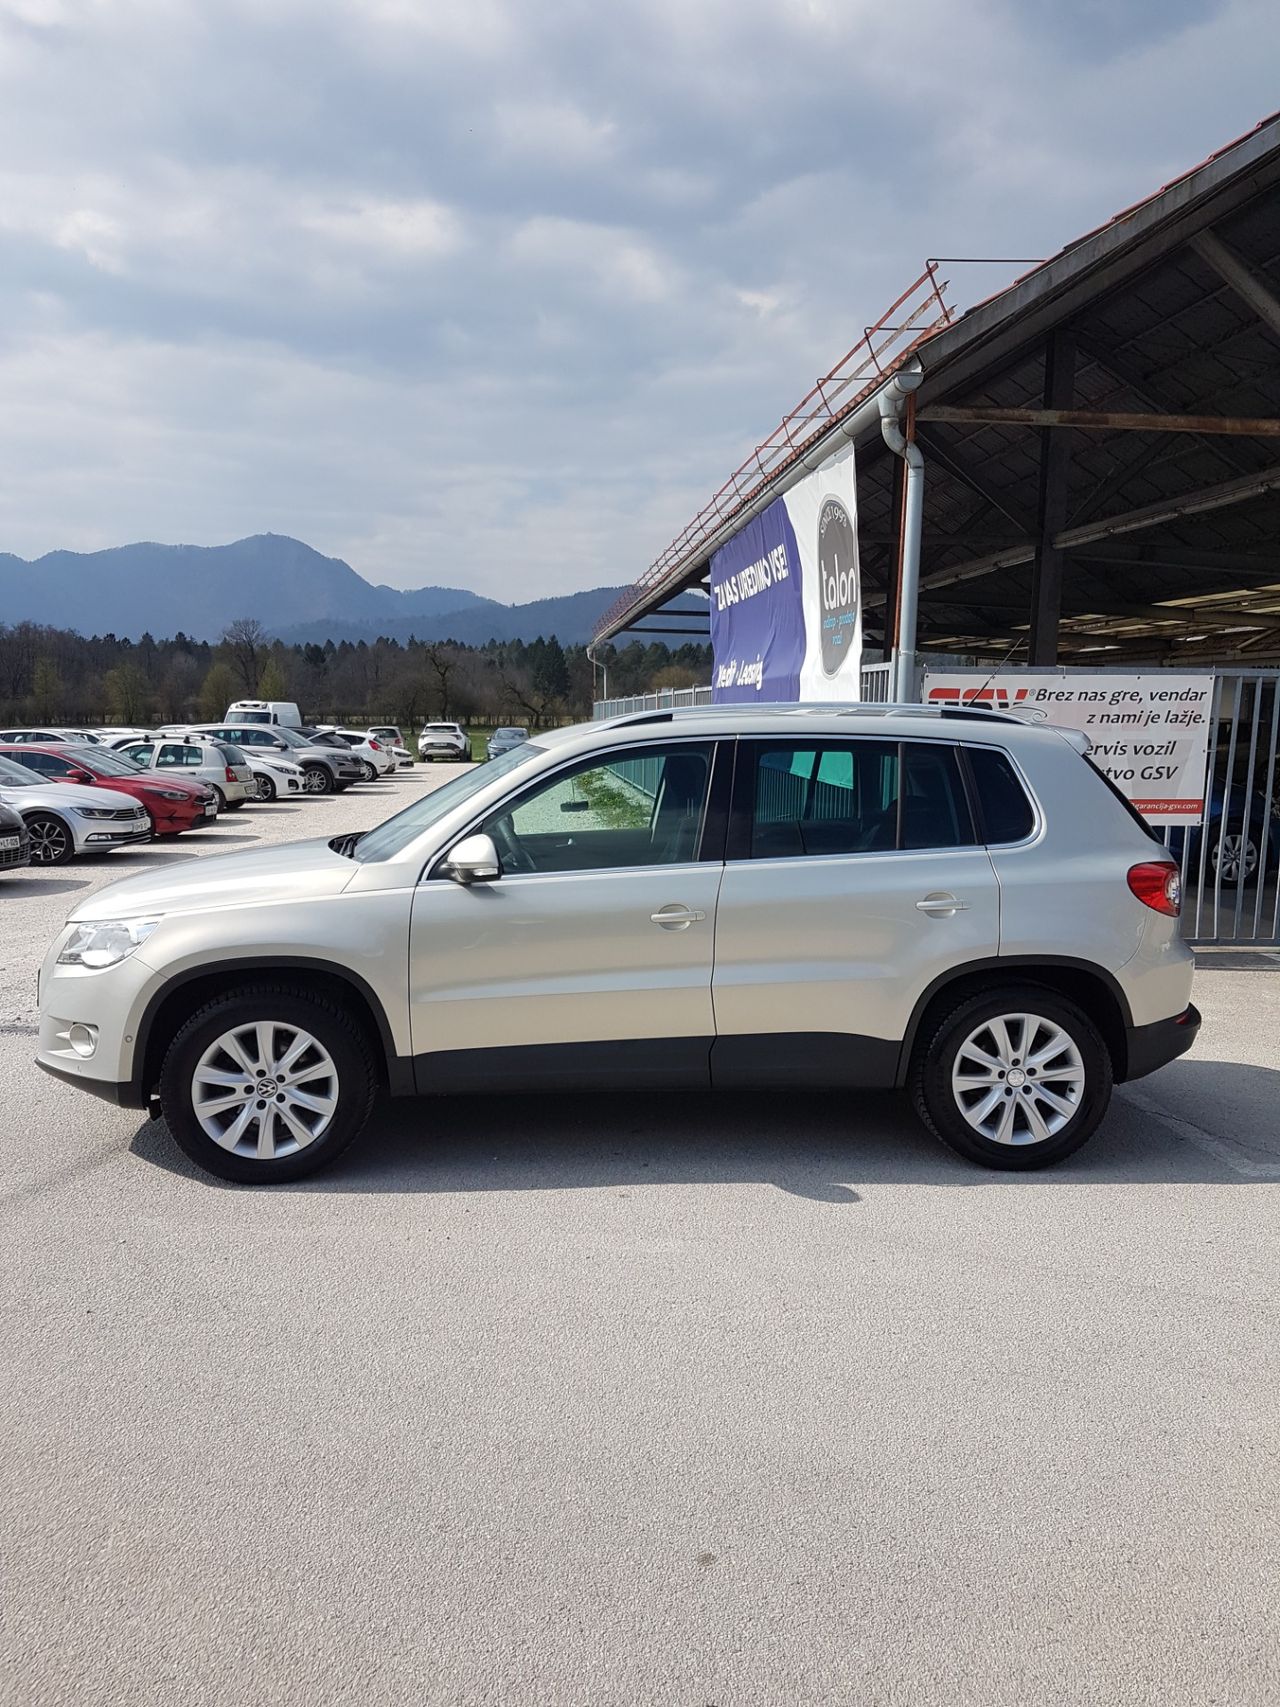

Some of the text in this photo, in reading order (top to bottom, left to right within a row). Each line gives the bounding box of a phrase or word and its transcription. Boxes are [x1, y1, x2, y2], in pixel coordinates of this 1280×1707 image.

[767, 543, 789, 583] VSE!
[821, 553, 857, 610] talon
[1035, 688, 1075, 702] Brez
[1077, 690, 1108, 702] nas
[1108, 690, 1144, 706] gre,
[1149, 687, 1208, 702] vendar
[1086, 710, 1206, 727] z nami je lažje.
[1086, 740, 1177, 756] ervis vozil
[1103, 766, 1179, 780] tvo GSV
